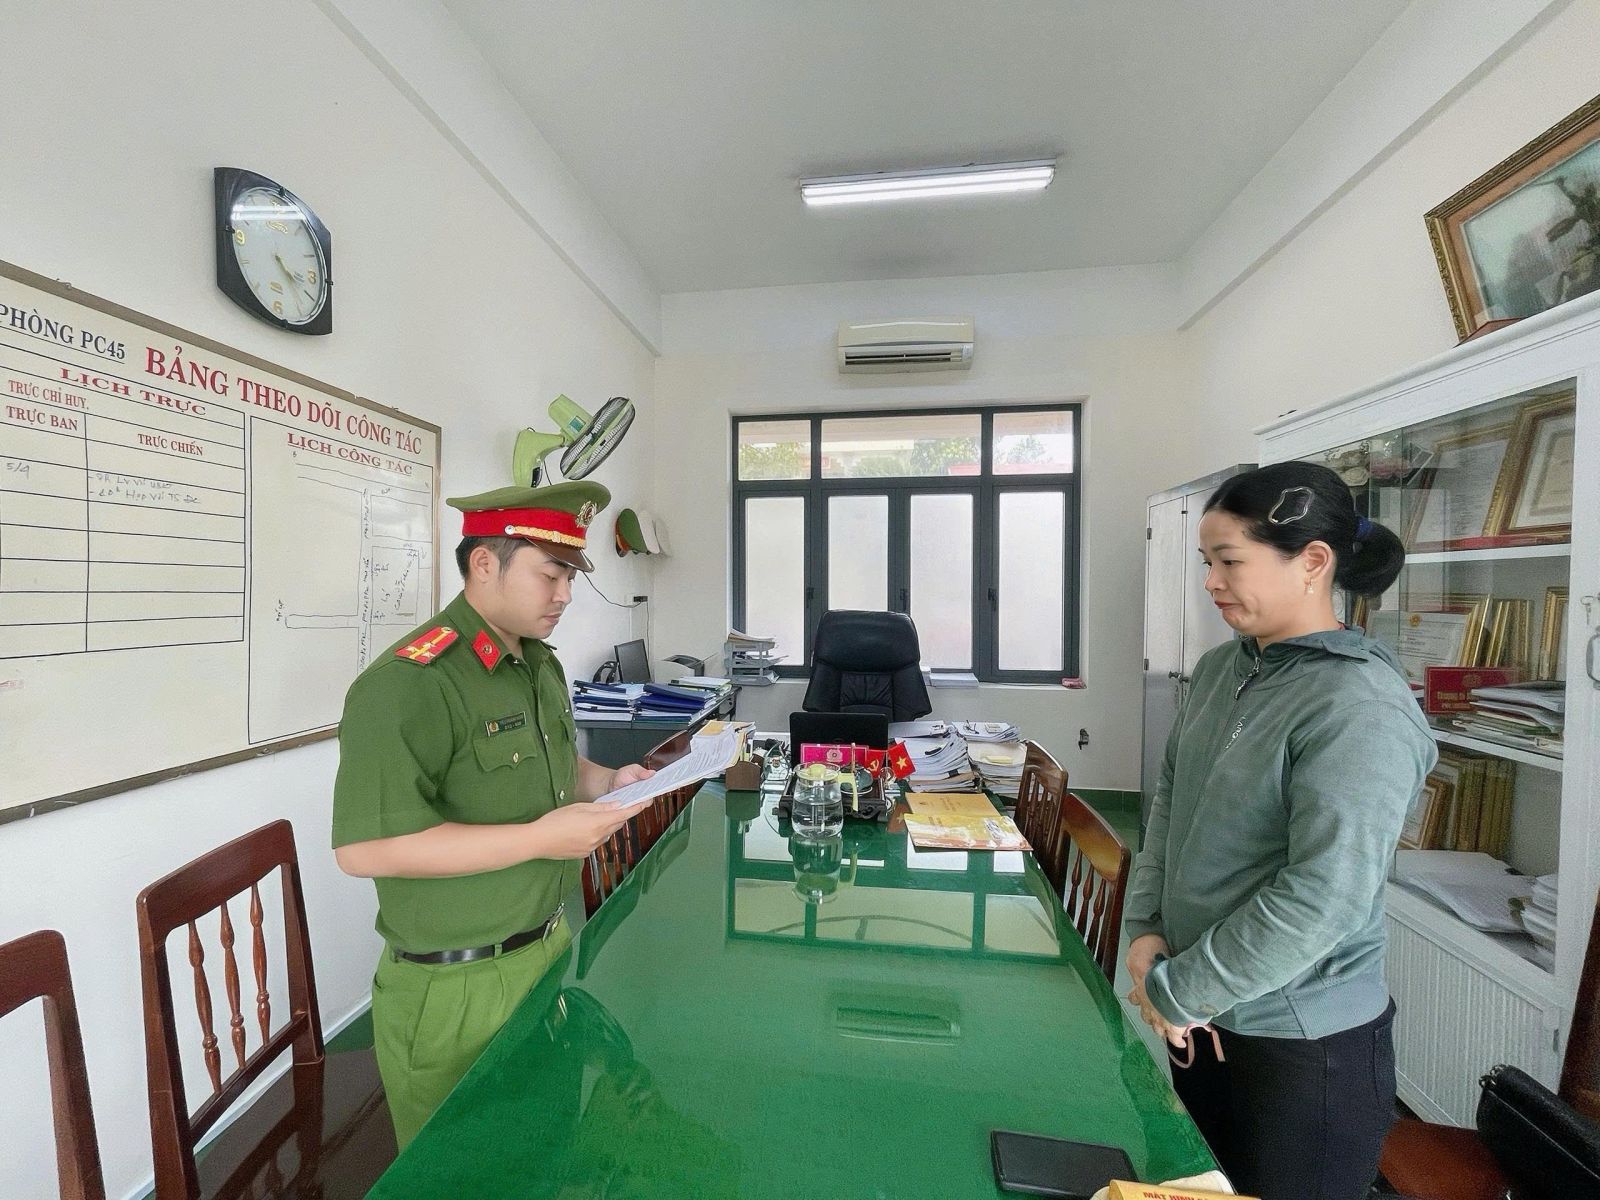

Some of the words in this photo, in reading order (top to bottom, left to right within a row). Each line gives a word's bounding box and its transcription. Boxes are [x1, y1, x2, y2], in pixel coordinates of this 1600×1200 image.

[308, 269, 317, 285] 3
[80, 330, 125, 360] PC45
[8, 380, 39, 399] TRỰC
[60, 368, 132, 396] LỊCH
[140, 390, 206, 415] TRỰC
[145, 346, 229, 396] BẢNG
[237, 378, 301, 417] THEO
[307, 402, 341, 430] DÕI
[347, 414, 391, 446] CÔNG
[396, 430, 422, 454] TÁC
[6, 405, 46, 425] TRỰC
[50, 415, 78, 431] BAN
[287, 433, 332, 454] LỊCH
[338, 449, 381, 467] CÔNG
[386, 459, 412, 475] TÁC
